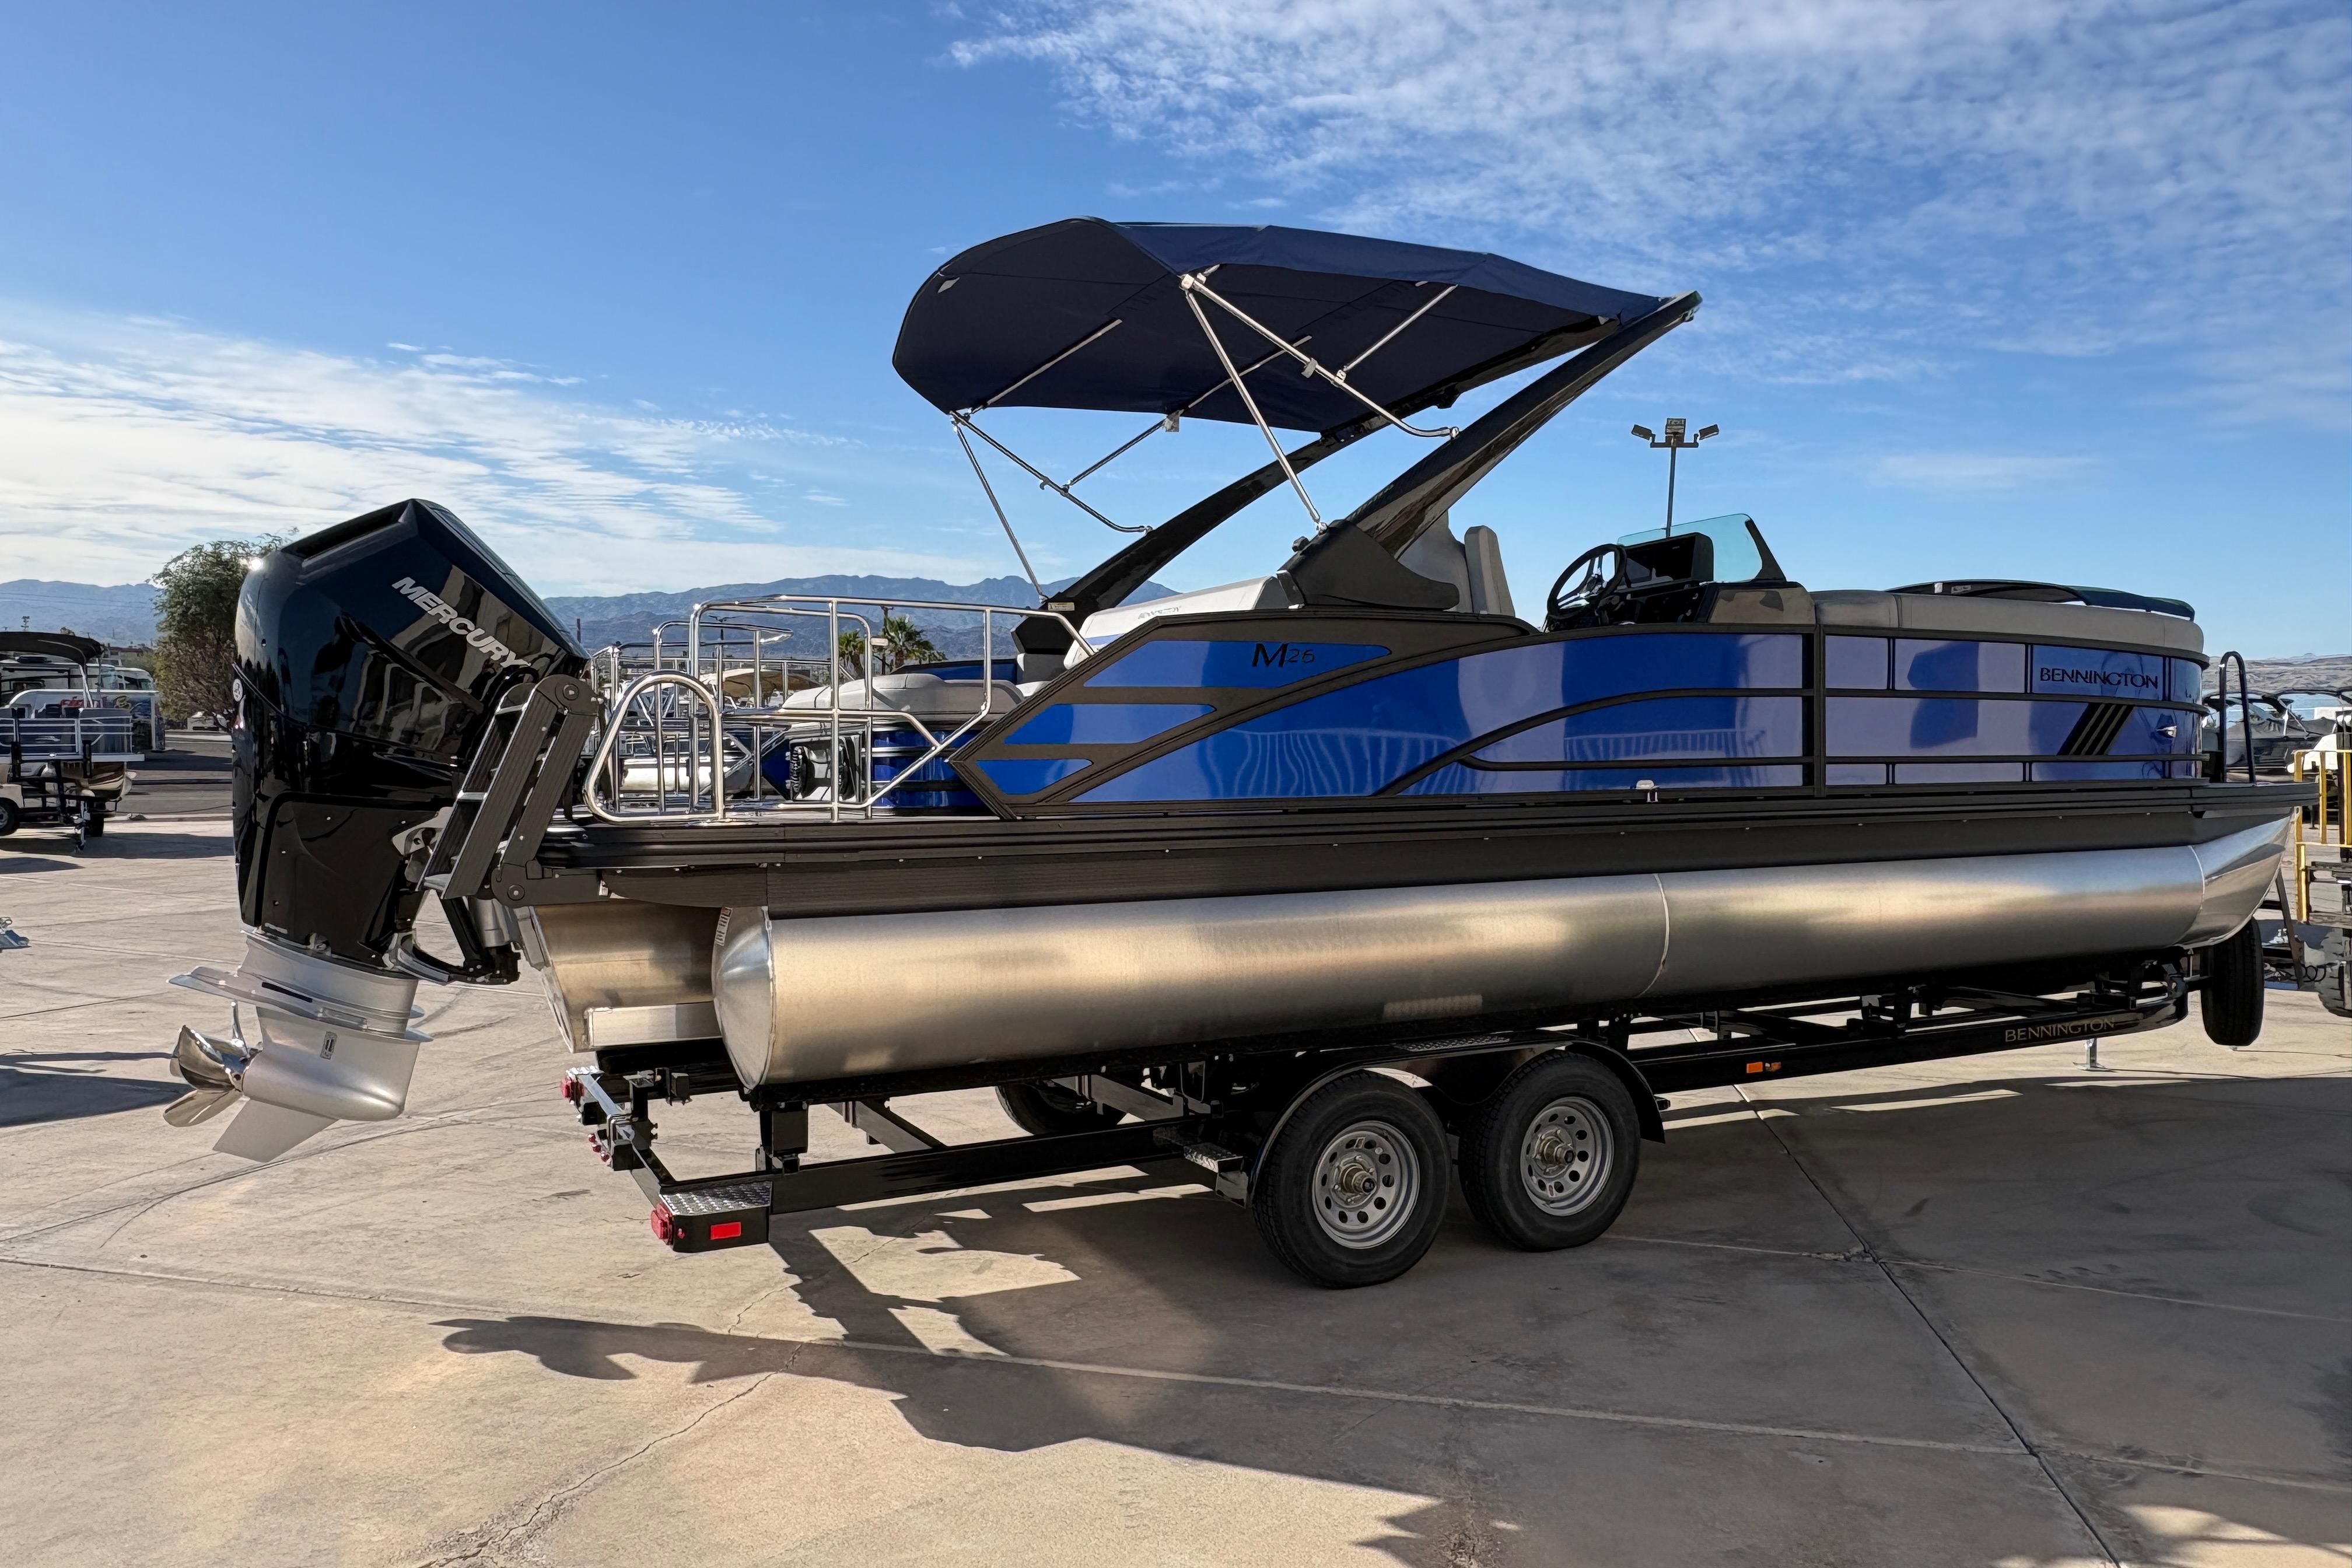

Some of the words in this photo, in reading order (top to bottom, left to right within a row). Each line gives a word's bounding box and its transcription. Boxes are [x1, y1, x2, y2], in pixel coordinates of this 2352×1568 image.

[391, 577, 531, 668] MERCURY
[2040, 667, 2158, 690] BENNINGTON
[2004, 1018, 2115, 1042] BENNINGTON
